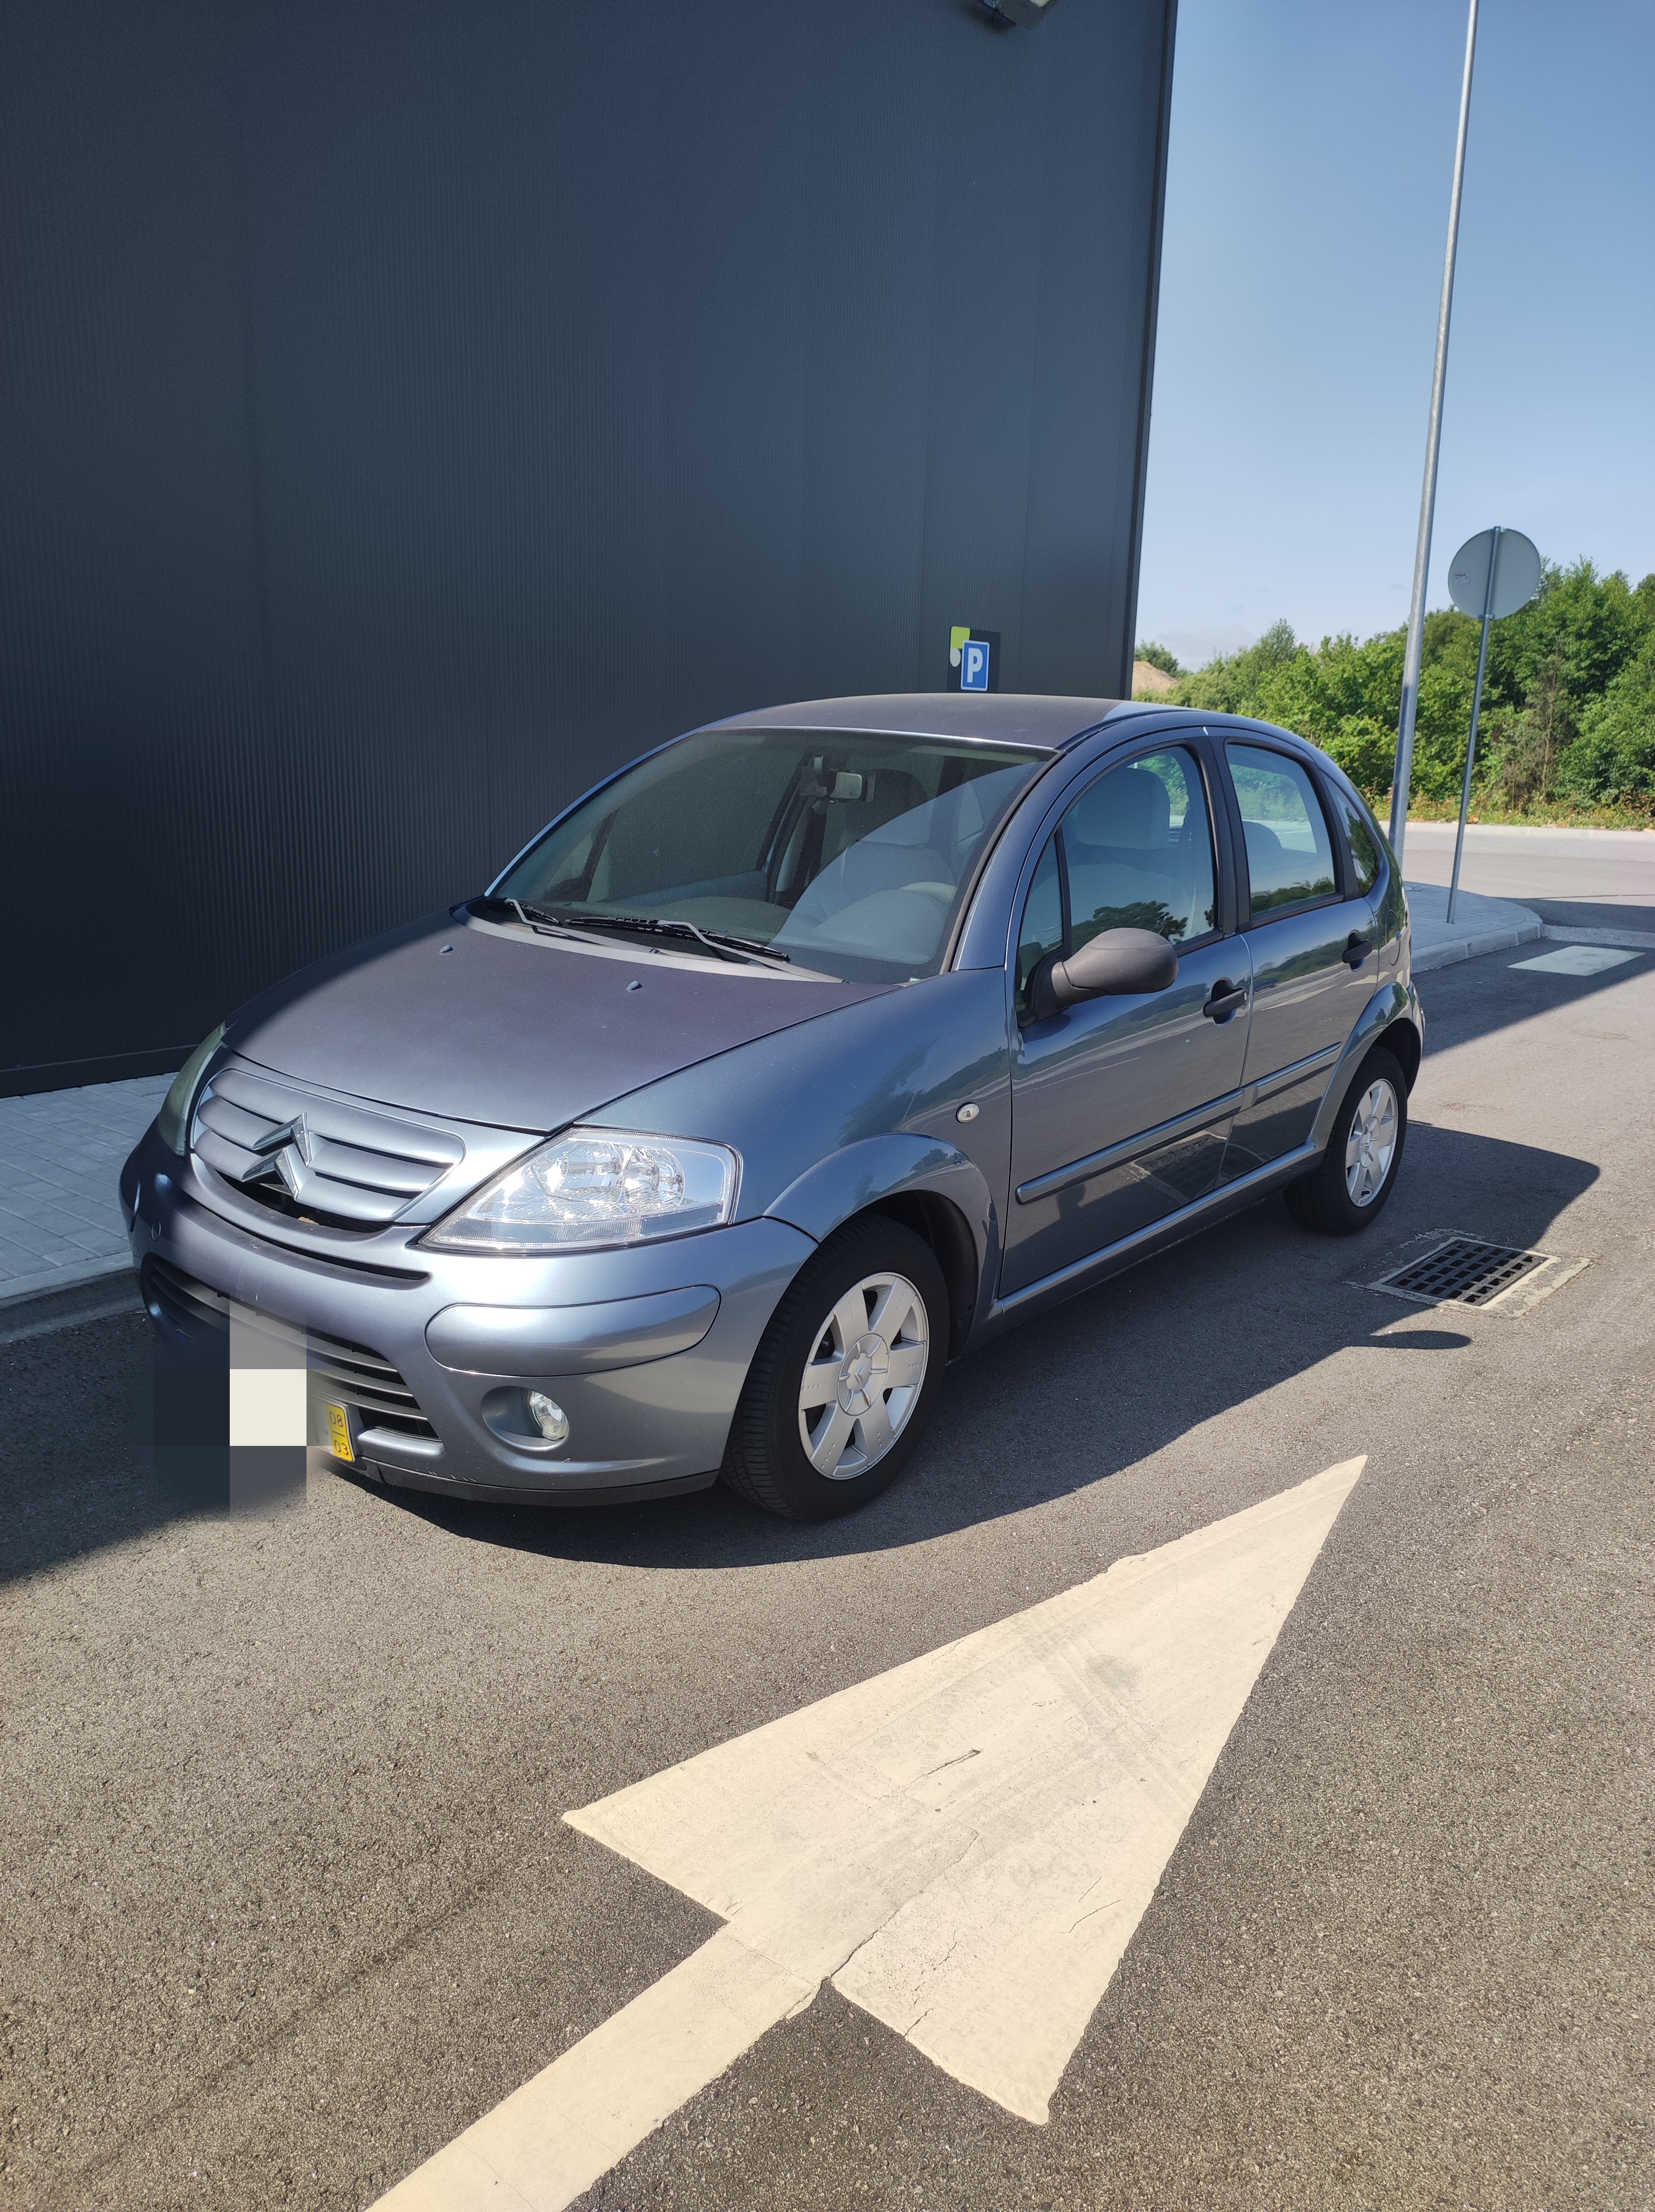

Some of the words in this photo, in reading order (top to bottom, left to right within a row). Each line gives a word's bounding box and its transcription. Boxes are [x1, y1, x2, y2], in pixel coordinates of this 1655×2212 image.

[967, 647, 983, 683] P
[329, 1412, 343, 1427] 08
[334, 1439, 349, 1455] 03
